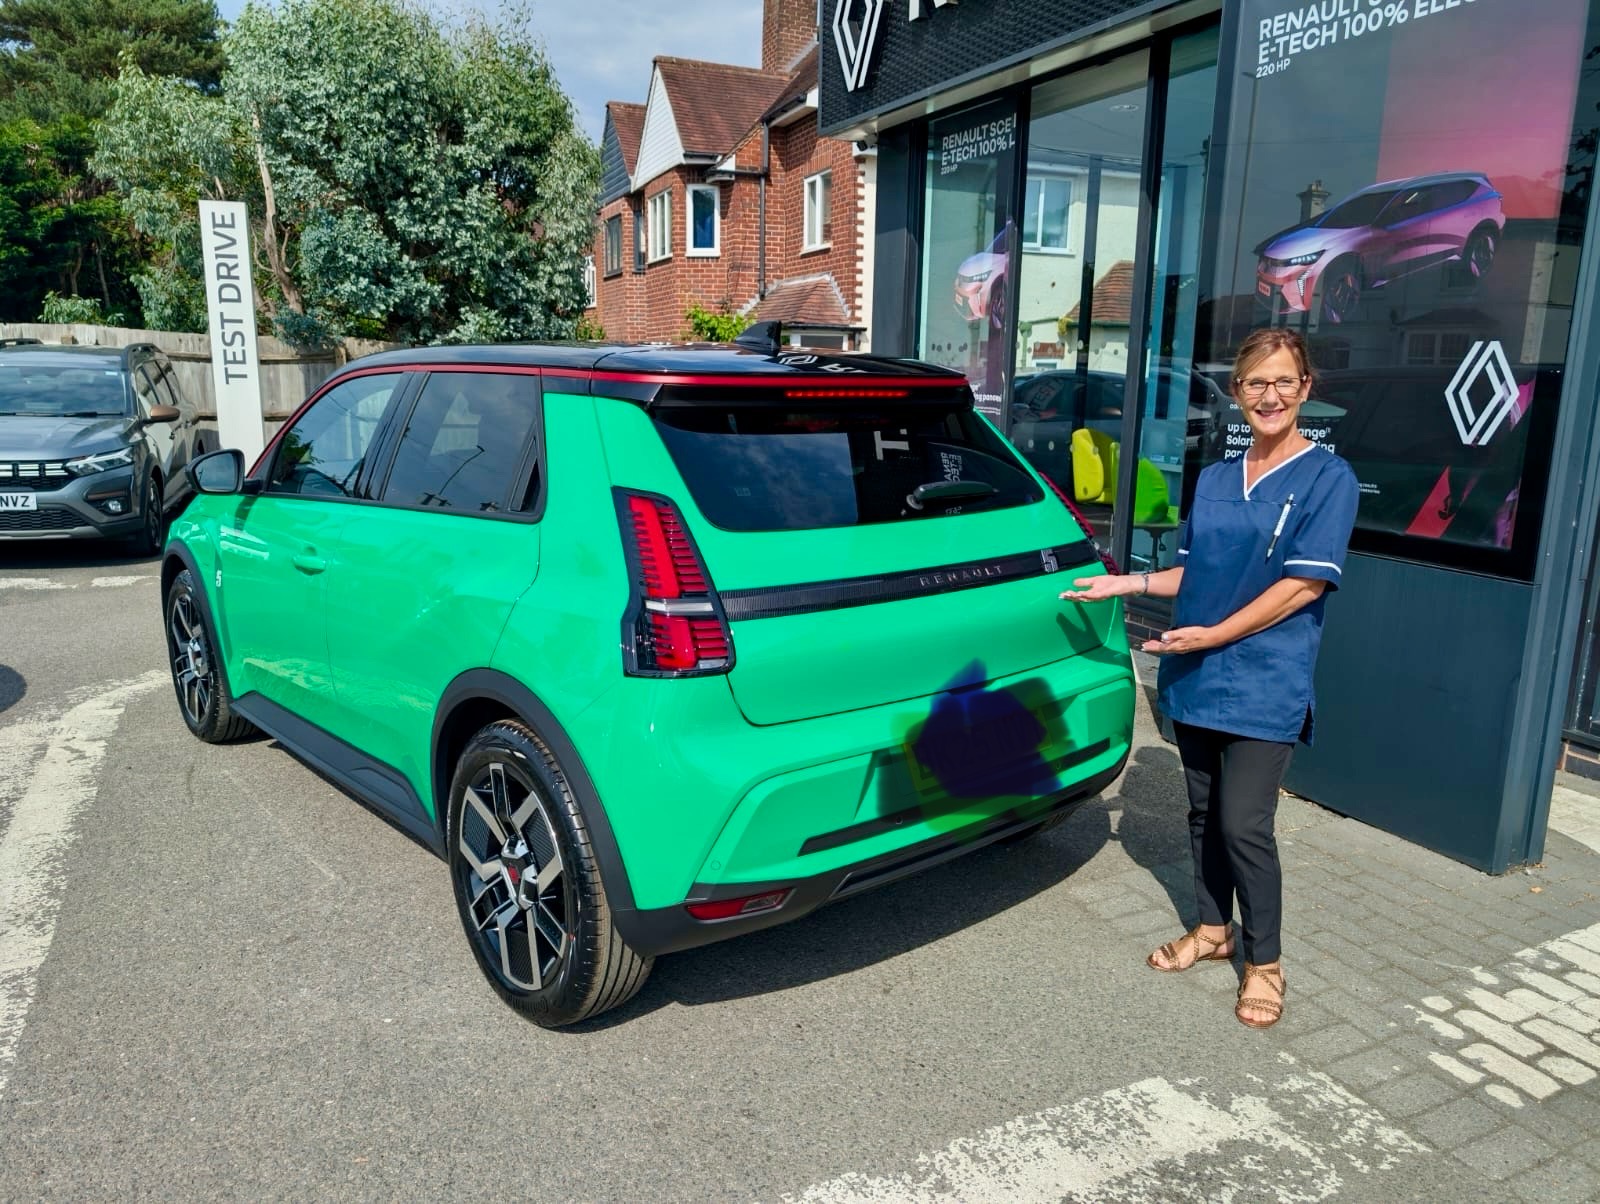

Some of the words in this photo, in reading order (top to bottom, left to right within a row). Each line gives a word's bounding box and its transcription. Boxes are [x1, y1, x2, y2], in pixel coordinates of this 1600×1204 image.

[1258, 21, 1338, 65] E-TECH
[1342, 0, 1409, 40] 100%
[1413, 0, 1477, 19] EL
[1256, 63, 1275, 78] 220
[1276, 58, 1291, 72] HP
[942, 124, 989, 151] RENAULT
[989, 112, 1017, 137] SCE
[941, 143, 978, 166] E-TECH
[979, 135, 1007, 156] 100%
[211, 211, 242, 304] DRIVE
[220, 311, 248, 385] TEST
[1240, 424, 1251, 433] to
[0, 495, 31, 508] NVZ
[919, 565, 1003, 587] RENAULT
